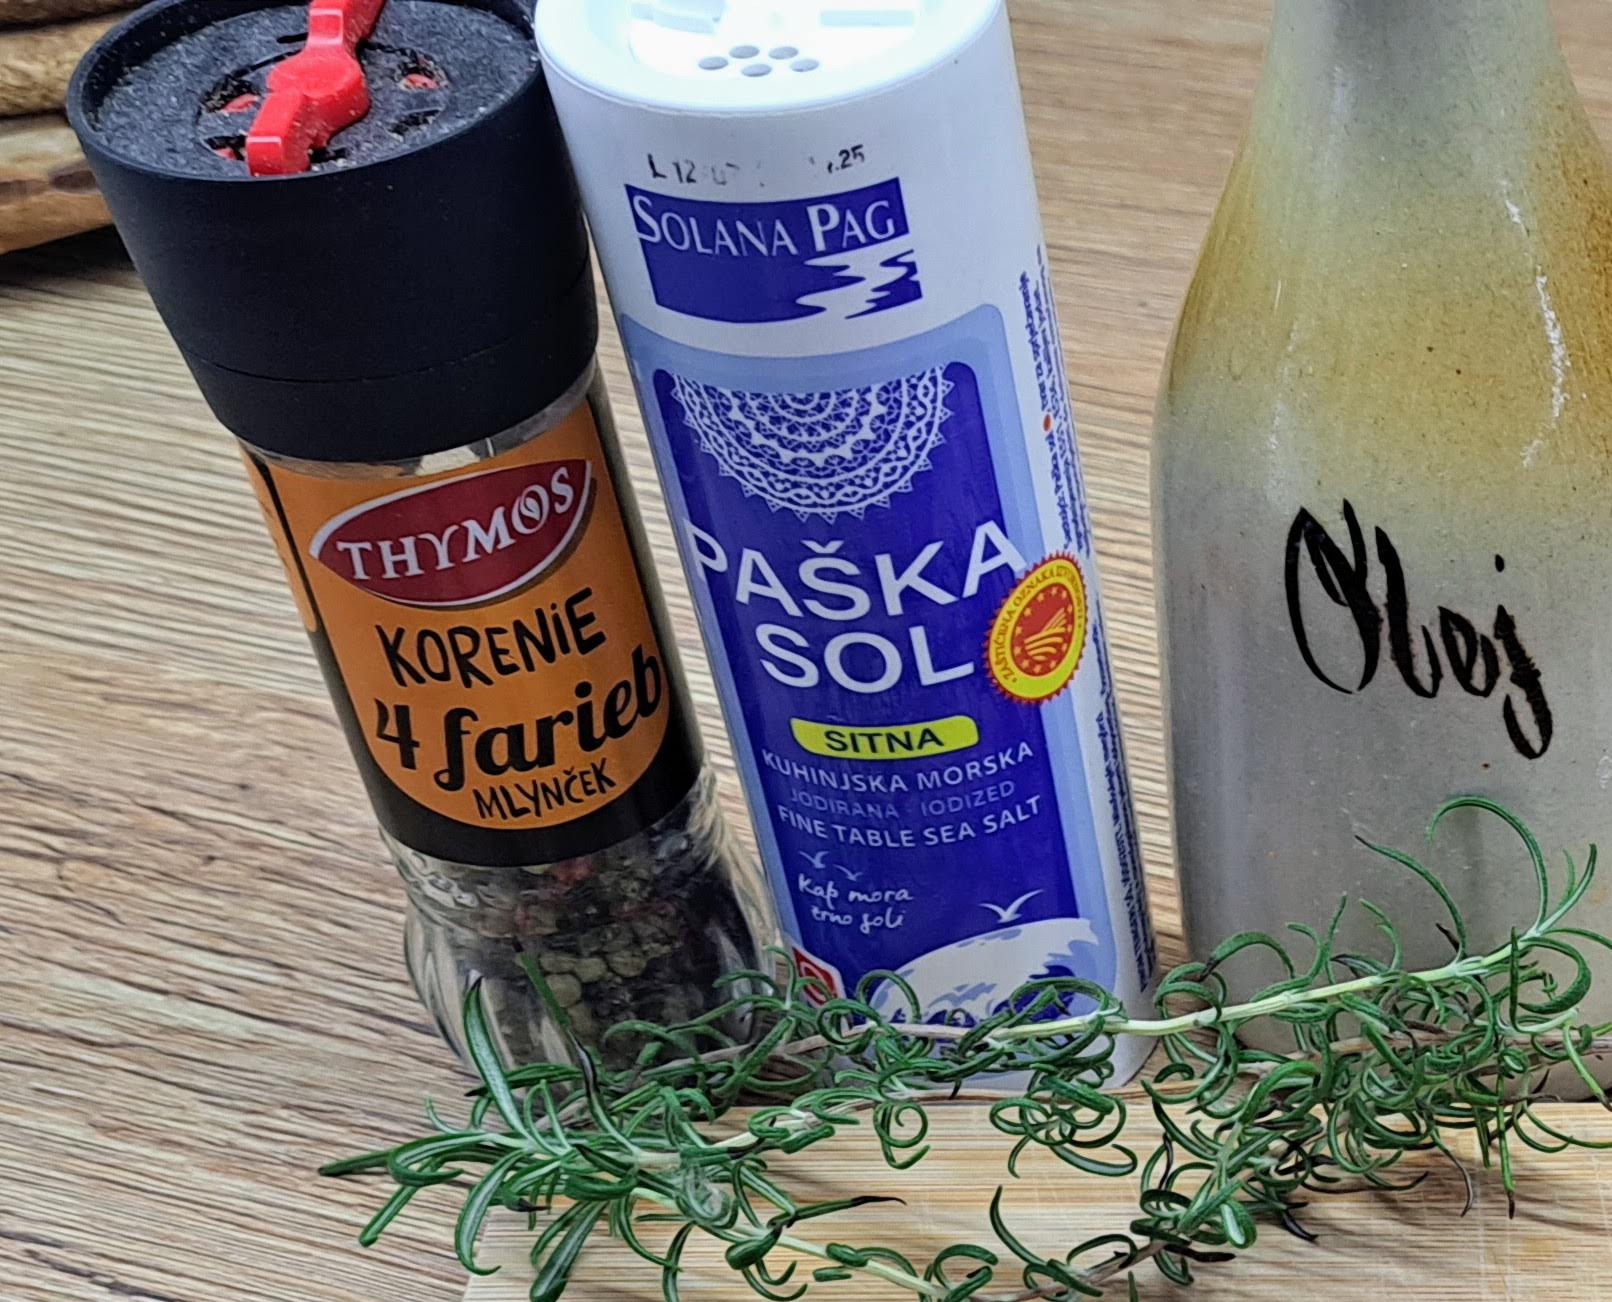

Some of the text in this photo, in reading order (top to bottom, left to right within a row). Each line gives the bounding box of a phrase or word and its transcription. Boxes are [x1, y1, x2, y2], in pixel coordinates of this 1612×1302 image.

[633, 195, 896, 257] SOLANA PAG
[336, 466, 576, 580] THYMOS
[682, 517, 1027, 622] PAŠKA
[375, 587, 607, 689] KORENiE
[755, 623, 974, 694] SOL
[374, 643, 664, 791] 4 farieb
[823, 728, 945, 754] SITNA
[473, 757, 617, 820] MLYNČEK
[761, 740, 1034, 793] KUHINJSKA MORSKA
[777, 794, 1041, 848] FINE TABLE SEA SALT
[789, 779, 1016, 819] JODIRANA IODIZED
